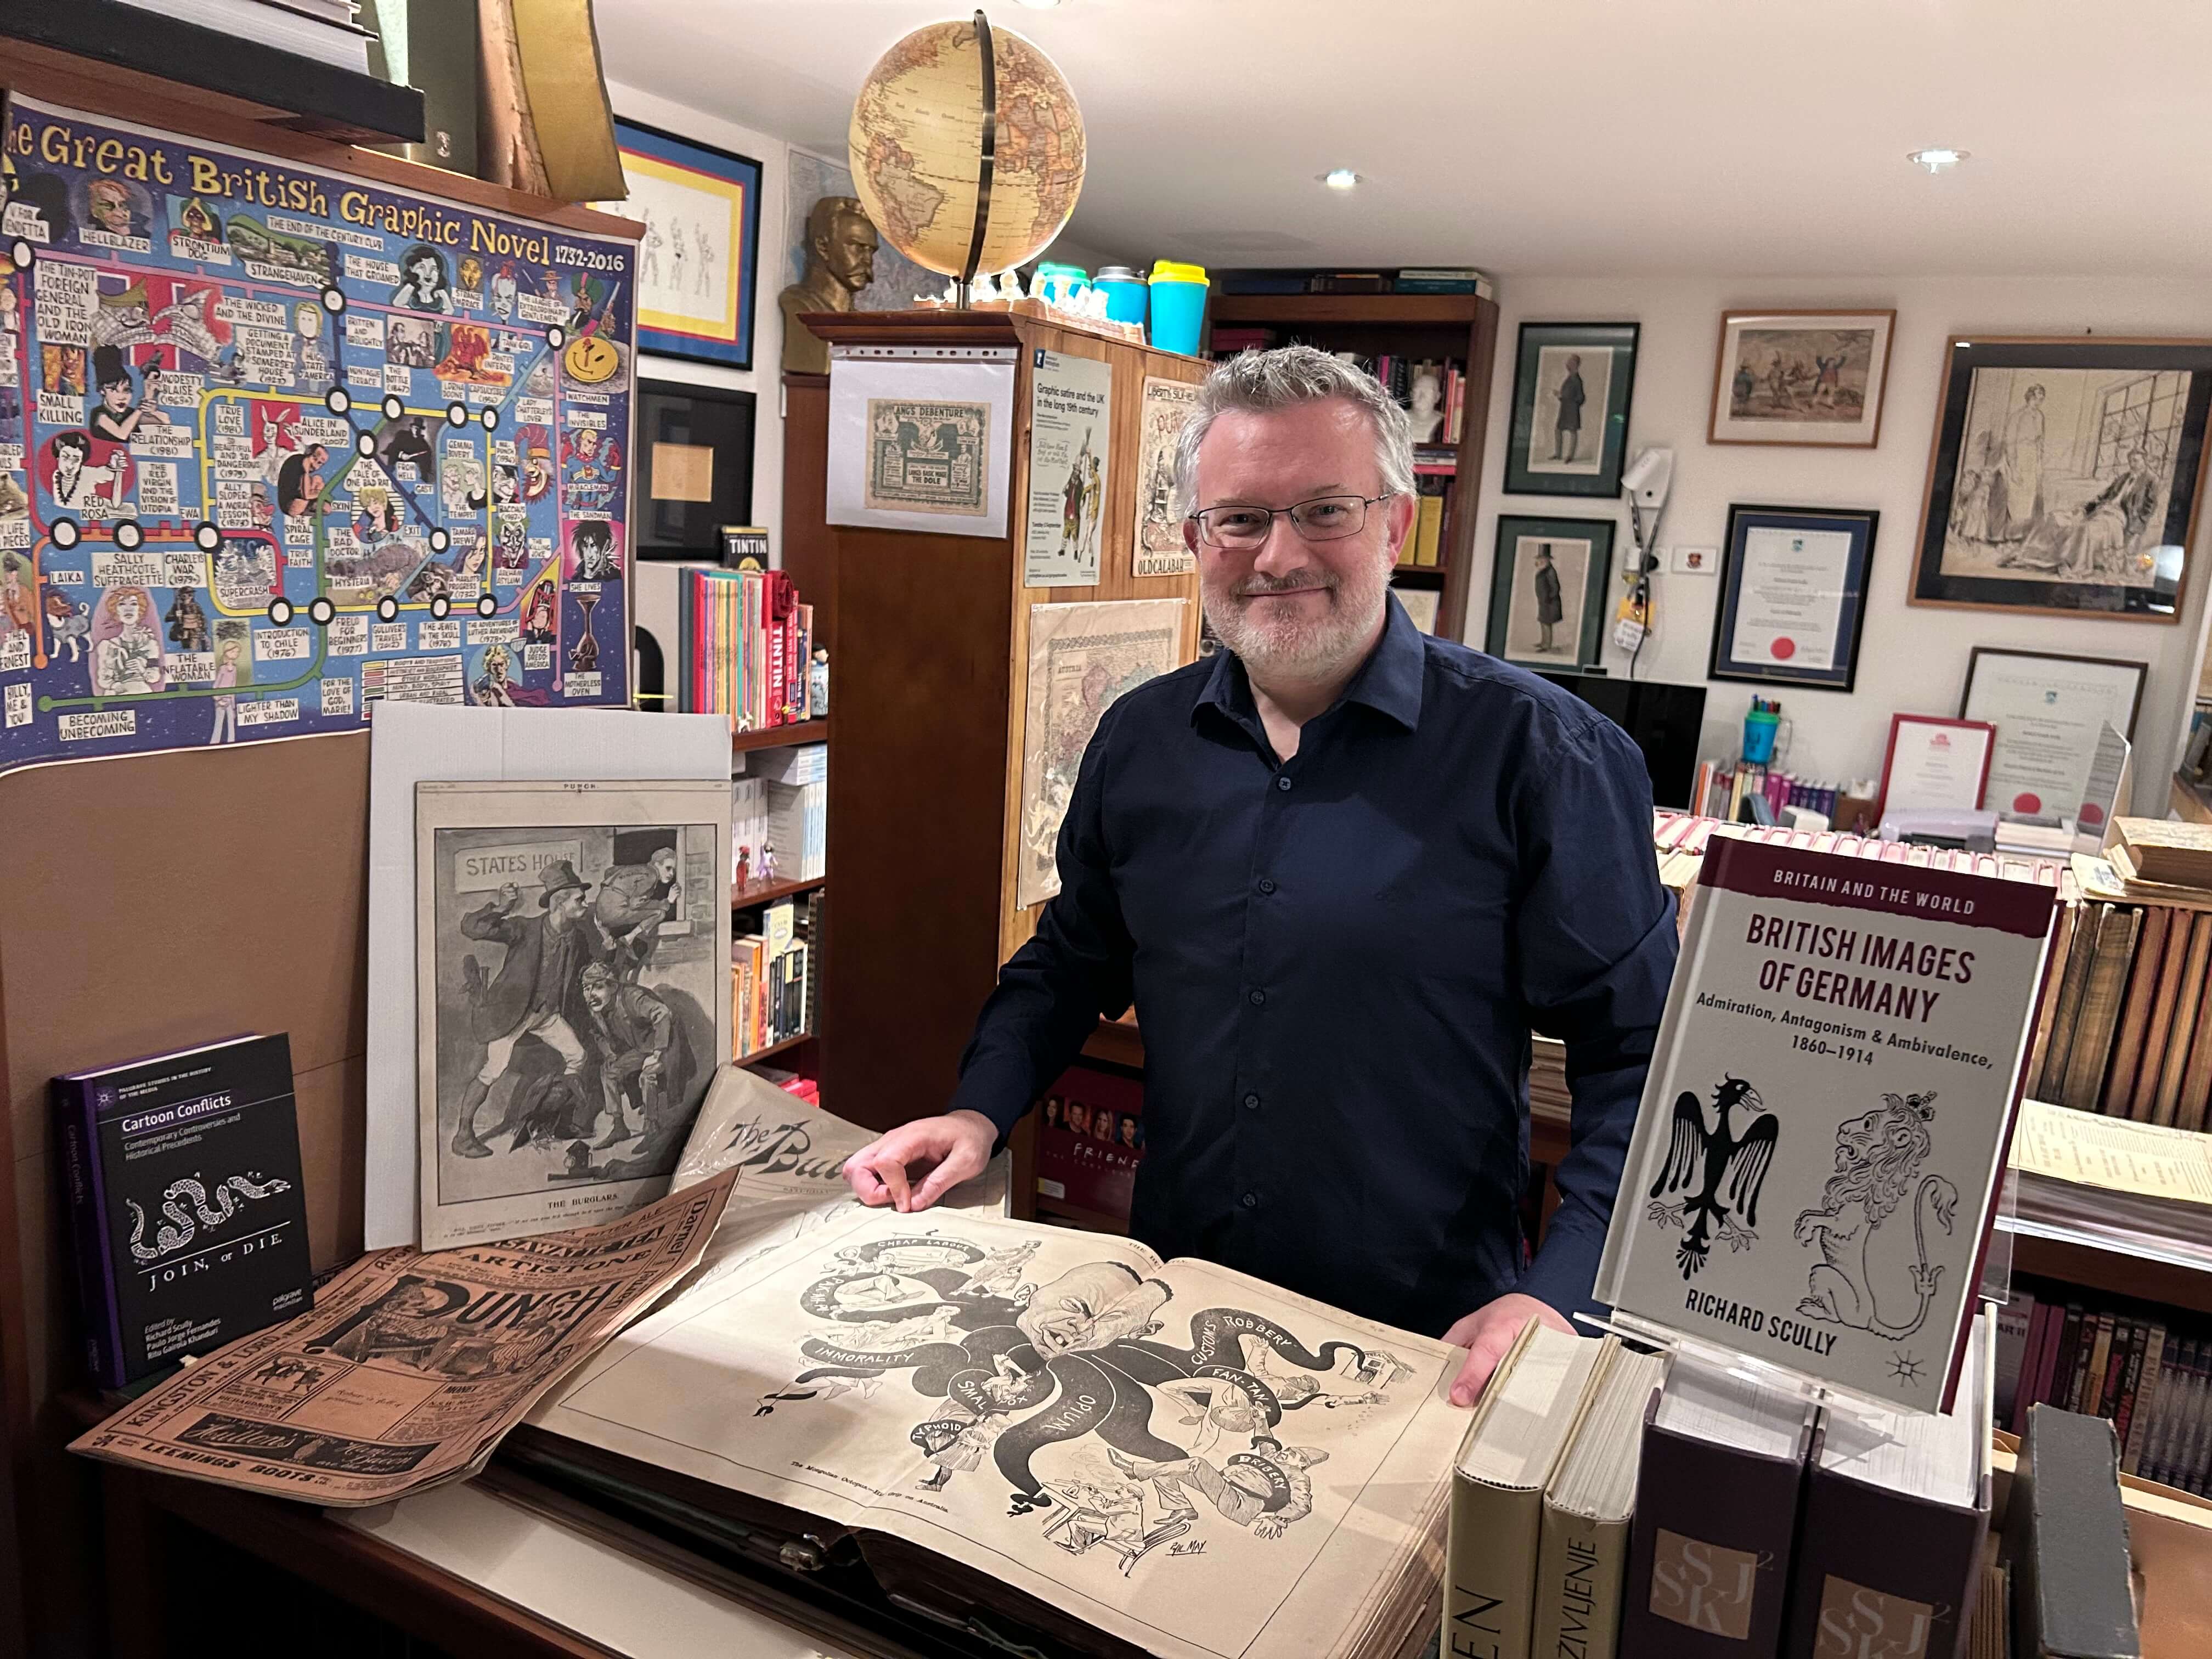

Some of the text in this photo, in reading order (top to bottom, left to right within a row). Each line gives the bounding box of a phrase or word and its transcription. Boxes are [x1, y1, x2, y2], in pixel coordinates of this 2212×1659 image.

[41, 124, 625, 272] Great British Graphic Novel 1732-2016
[83, 229, 149, 251] HELLBLAZER
[270, 218, 383, 250] THE END OF THE CENTURY CLUB
[173, 235, 229, 255] STRONTIUM
[188, 249, 208, 261] DOG
[40, 261, 95, 281] THE TIN-POT
[251, 264, 319, 284] STRANGEHAVEN
[42, 275, 89, 294] FOREIGN
[35, 289, 85, 307] GENERAL
[37, 303, 87, 320] AND THE
[37, 316, 92, 332] OLD IRON
[44, 330, 87, 343] WOMAN
[40, 394, 75, 409] SMALL
[567, 393, 608, 403] WATCHMEN
[1037, 383, 1105, 404] Graphic satire and the UK
[39, 407, 82, 423] KILLING
[919, 407, 964, 418] DEBENTURE
[1037, 397, 1099, 419] in the long 19th century
[84, 495, 104, 507] RED
[82, 509, 109, 519] ROSA
[730, 539, 767, 554] TINTIN
[114, 554, 144, 564] SALLY
[1138, 558, 1184, 575] OLD CALABAR
[52, 572, 82, 584] LAIKA
[94, 575, 163, 587] SUFFRAGETTE
[221, 587, 268, 598] SUPERCRASH
[772, 626, 783, 688] TINTIN
[238, 698, 295, 714] LIGHTER THAN
[70, 712, 128, 727] BECOMING
[244, 709, 297, 724] MY SHADOW
[60, 721, 134, 740] UNBECOMING
[466, 855, 527, 876] STATES
[1773, 870, 1976, 916] BRITAIN AND THE WORLD
[1746, 913, 1976, 985] BRITISH IMAGES
[1759, 959, 1940, 1024] OF GERMANY
[1696, 991, 1994, 1070] Admiration, Antagonism & Ambivalence,
[119, 1082, 146, 1093] PALGRAVE
[148, 1077, 170, 1087] STUDIES
[189, 1066, 212, 1076] HISTORY
[140, 1086, 159, 1095] MEDIA
[122, 1095, 232, 1132] Cartoon Conflicts
[125, 1113, 241, 1151] Contemporary Controversies and
[723, 1114, 769, 1151] The
[126, 1134, 202, 1161] Historical Precedents
[548, 1200, 566, 1209] THE
[618, 1225, 664, 1250] TEA
[877, 1238, 970, 1252] CHEAP LABOUR
[1128, 1241, 1147, 1253] THE
[149, 1233, 283, 1293] JOIN, or DIE.
[463, 1246, 653, 1275] ARTISTONE
[273, 1289, 302, 1306] palgrave
[273, 1296, 303, 1311] macmillan
[302, 1274, 623, 1355] PUNCH
[1684, 1288, 1839, 1358] RICHARD SCULLY
[145, 1317, 175, 1334] Edited by
[145, 1319, 193, 1342] Richard Scully
[146, 1318, 221, 1351] Paulo Jorge Fernandes
[148, 1327, 219, 1361] Ritu Gairola Khanduri
[1190, 1315, 1292, 1366] CUSTOMS ROBBERY
[814, 1345, 916, 1364] IMMORALITY
[126, 1333, 282, 1427] KINGSTON & LORD
[443, 1384, 479, 1394] MONEY
[957, 1379, 985, 1410] SMAL
[1051, 1393, 1098, 1435] OPIUM
[913, 1421, 961, 1441] TYPHOID
[141, 1441, 241, 1469] LEEMINGS
[249, 1464, 316, 1483] BOOTS
[805, 1465, 838, 1479] Mongolian
[1238, 1454, 1287, 1490] BRIBERY
[1188, 1539, 1207, 1554] MAY
